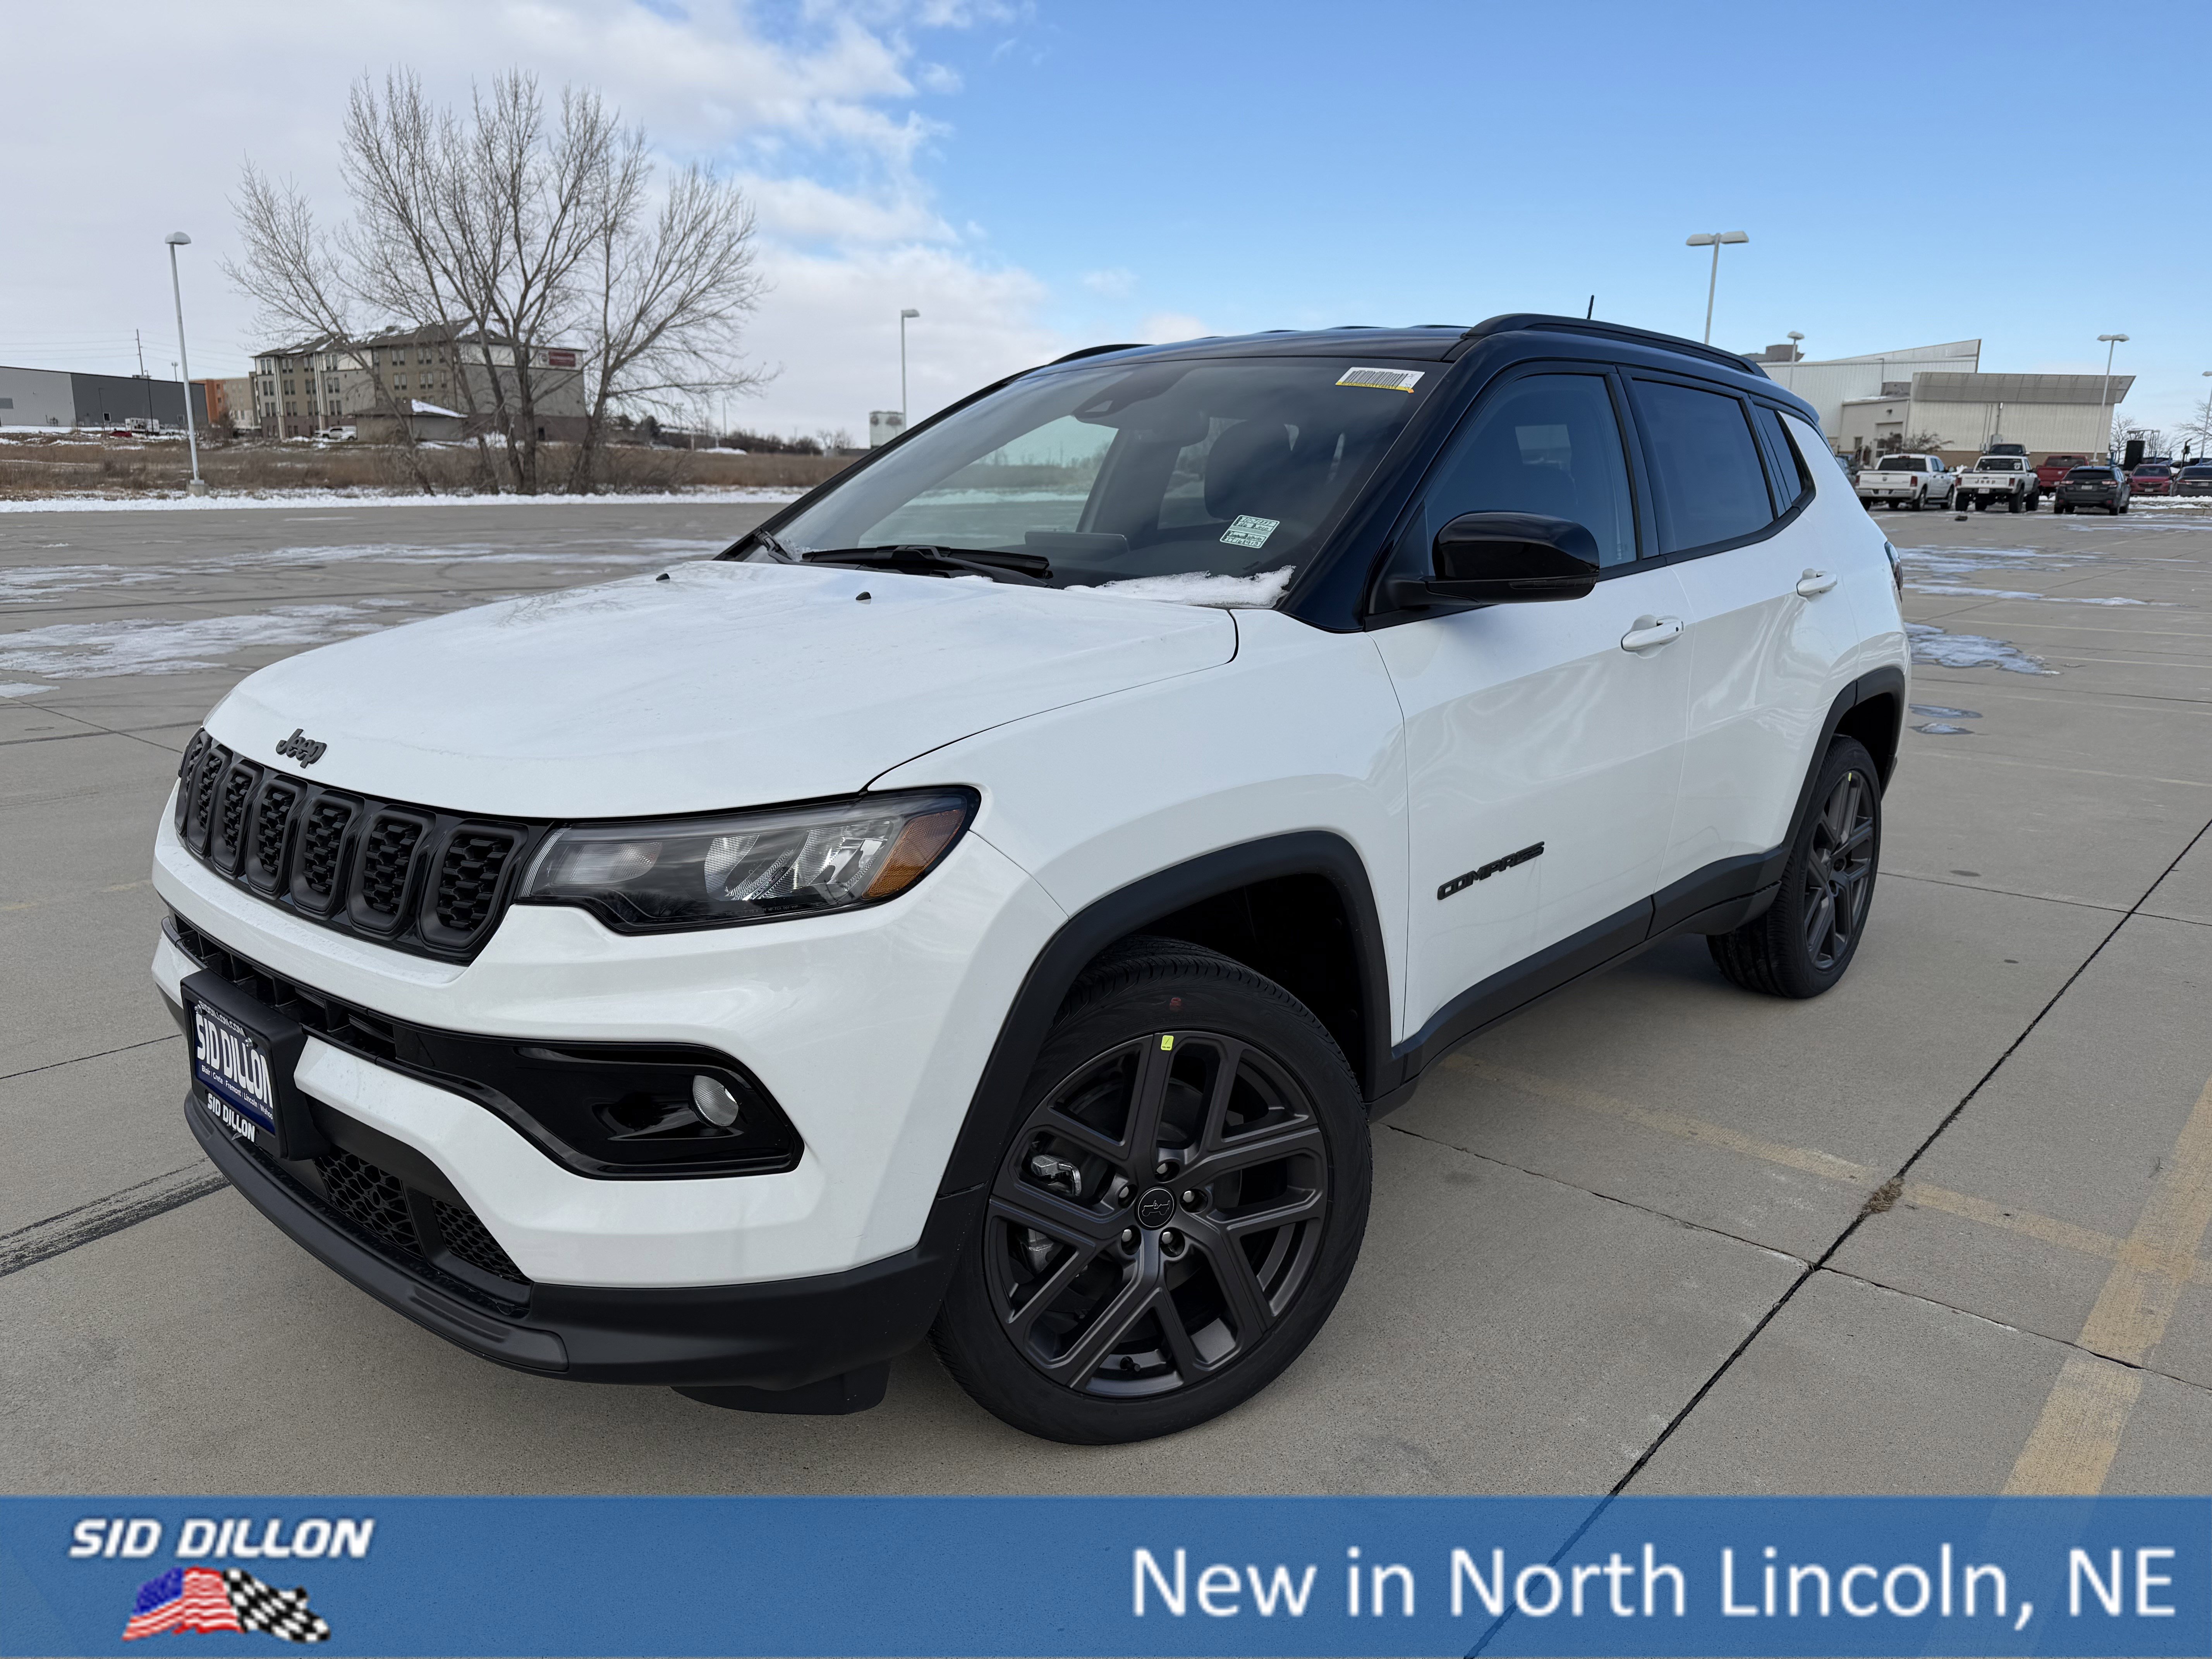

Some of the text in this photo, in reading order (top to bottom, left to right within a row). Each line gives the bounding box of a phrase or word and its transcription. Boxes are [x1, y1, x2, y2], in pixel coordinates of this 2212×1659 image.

[276, 728, 327, 769] Jeep
[1437, 841, 1544, 900] COMPASS
[196, 1013, 273, 1109] SID DILLON
[201, 1065, 273, 1120] Blair Crete Fremont Lincoln Wahoo
[208, 1093, 255, 1142] SID DILLON
